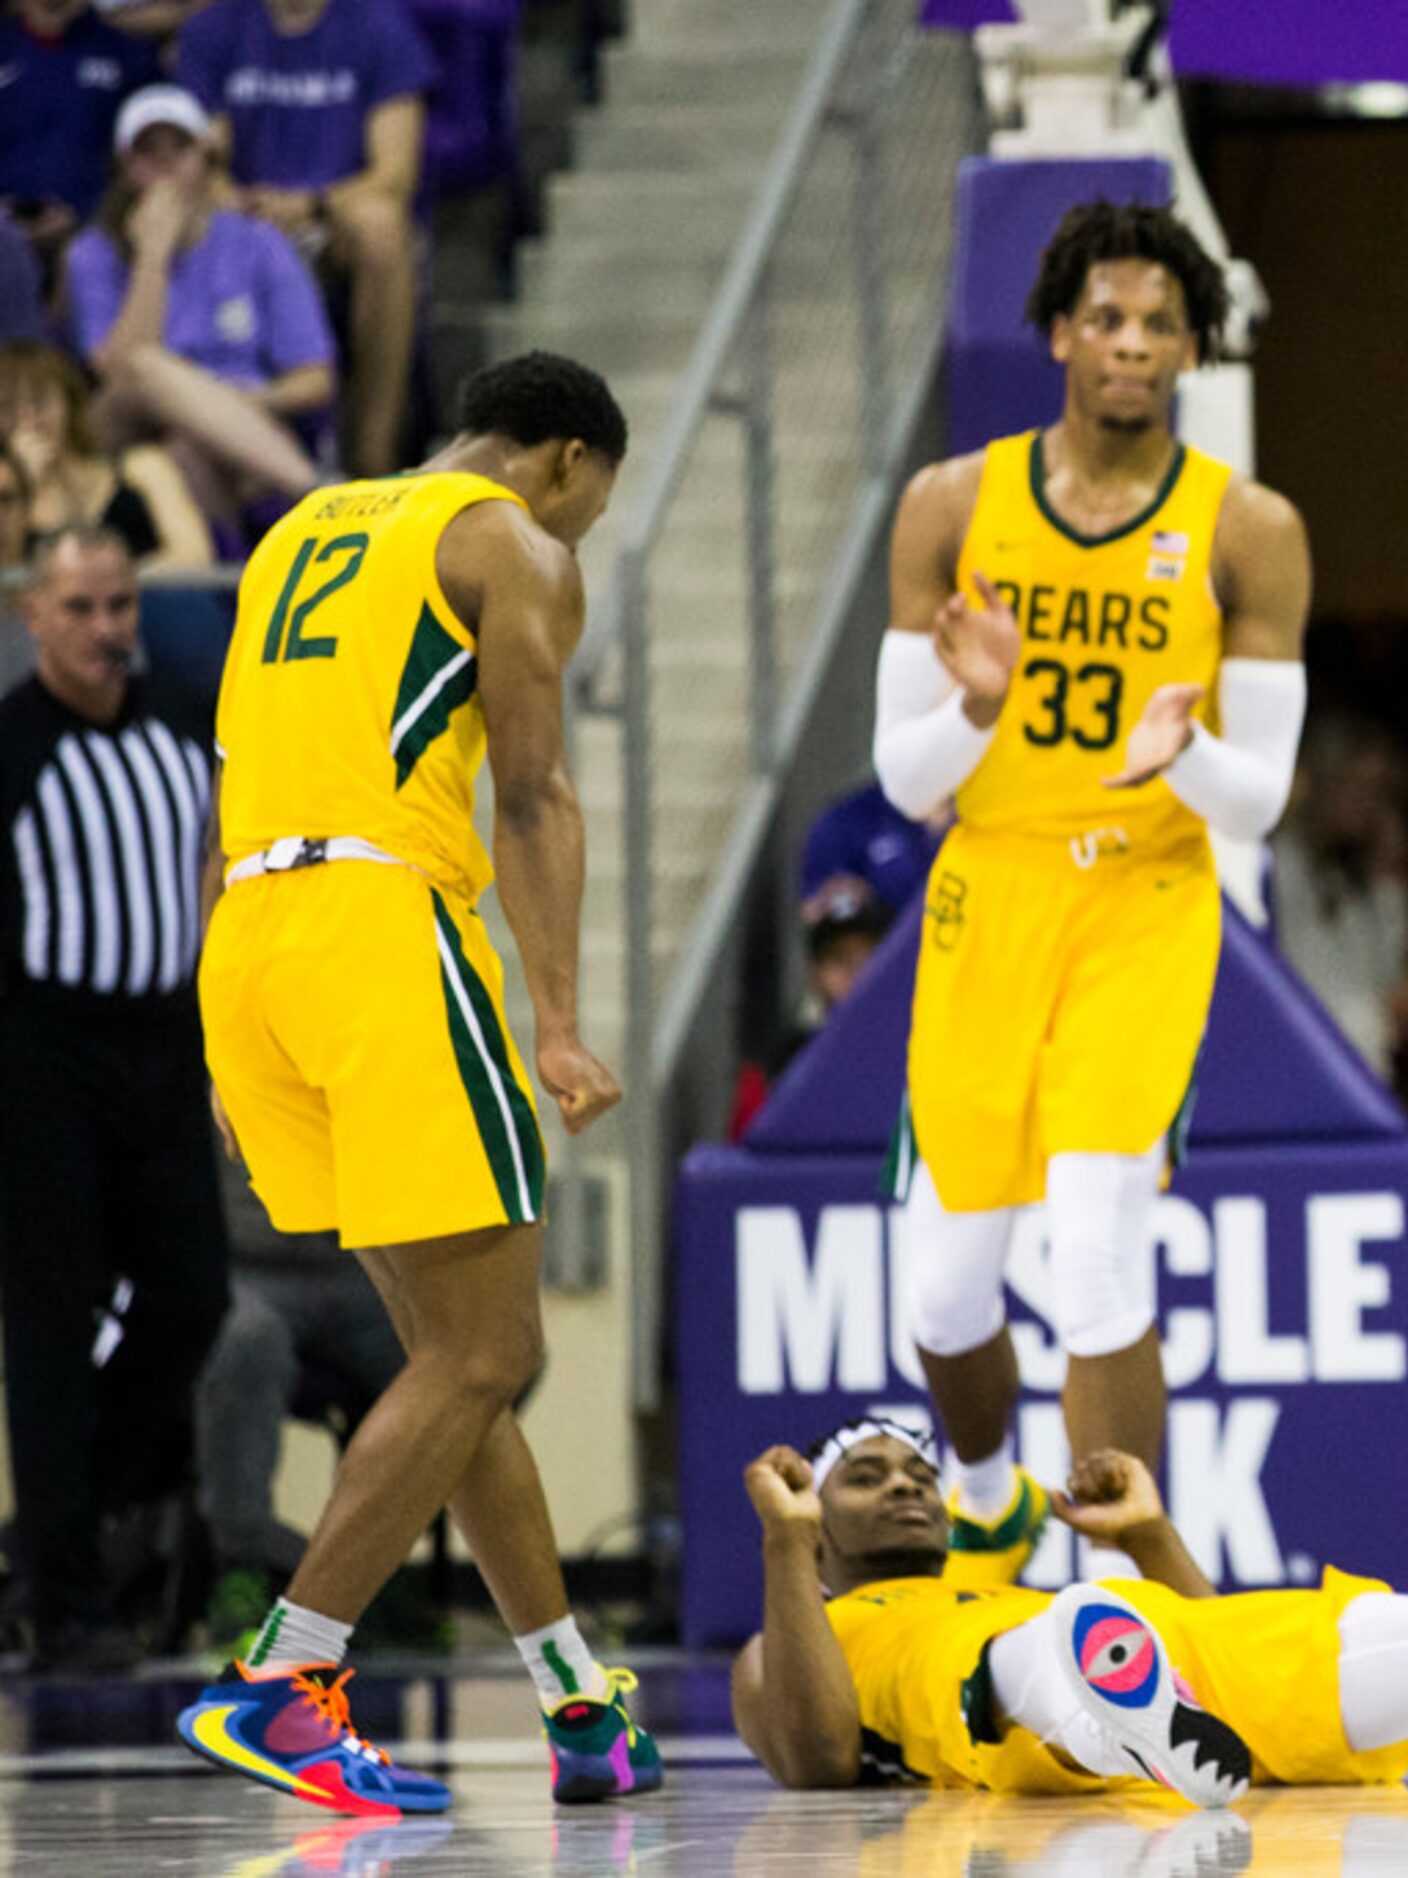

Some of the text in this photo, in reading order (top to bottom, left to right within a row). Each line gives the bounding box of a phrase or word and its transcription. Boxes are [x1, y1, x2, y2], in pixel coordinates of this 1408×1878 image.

[262, 532, 369, 664] 12
[1023, 659, 1123, 750] 33
[737, 1193, 1407, 1393] MSCLE
